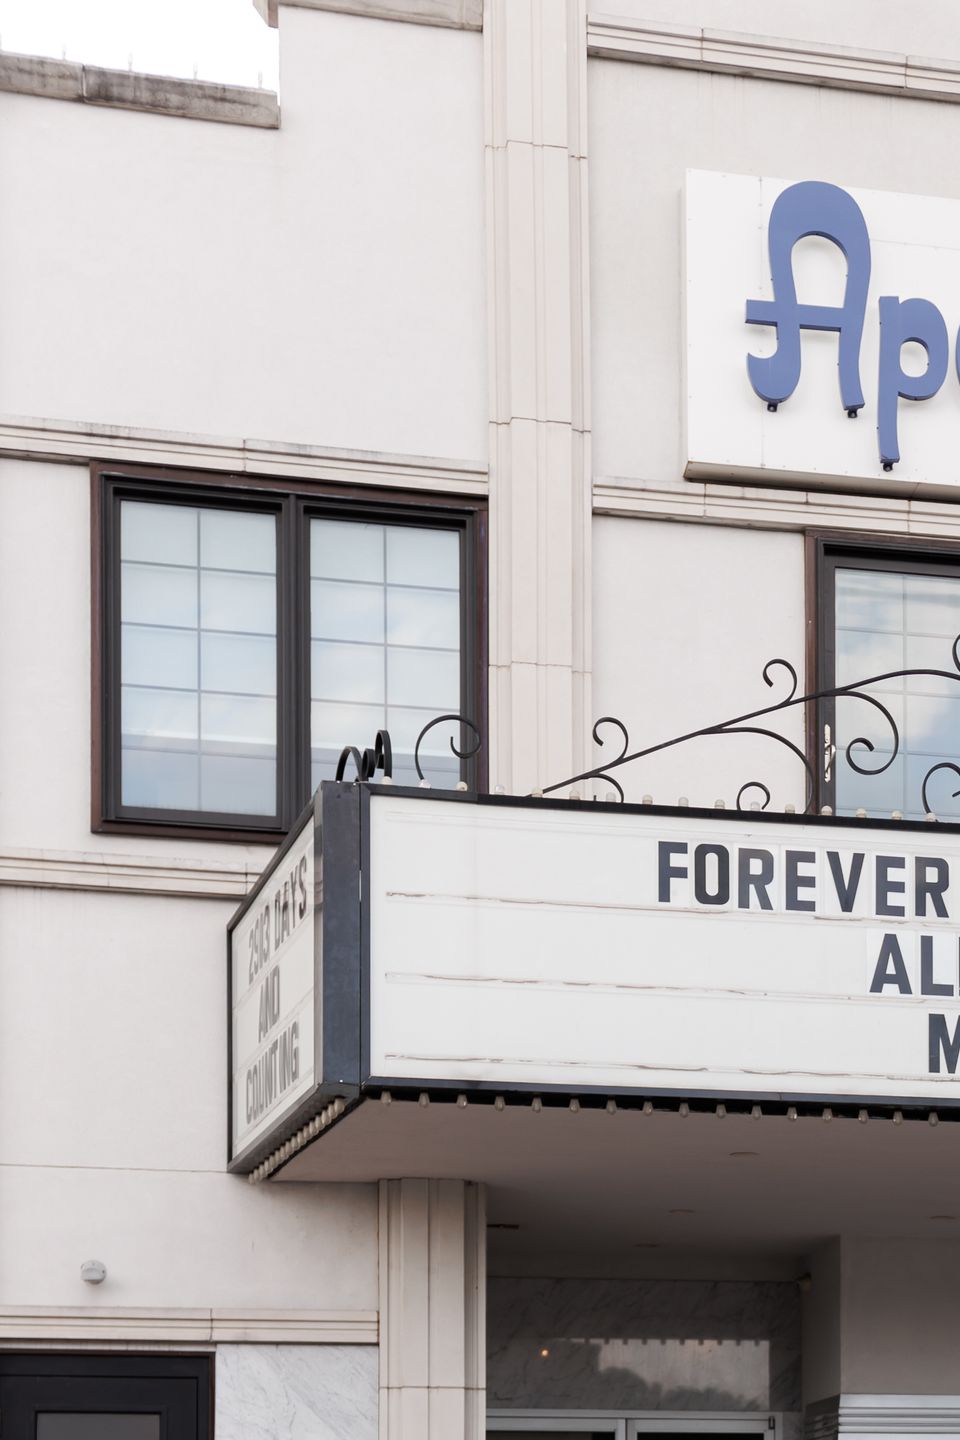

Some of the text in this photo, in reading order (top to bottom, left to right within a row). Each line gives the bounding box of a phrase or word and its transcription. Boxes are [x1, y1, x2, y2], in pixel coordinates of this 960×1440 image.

[274, 856, 307, 951] DAYS
[659, 841, 949, 917] FOREVER
[258, 964, 280, 1043] AND
[246, 1021, 299, 1125] COUNTING
